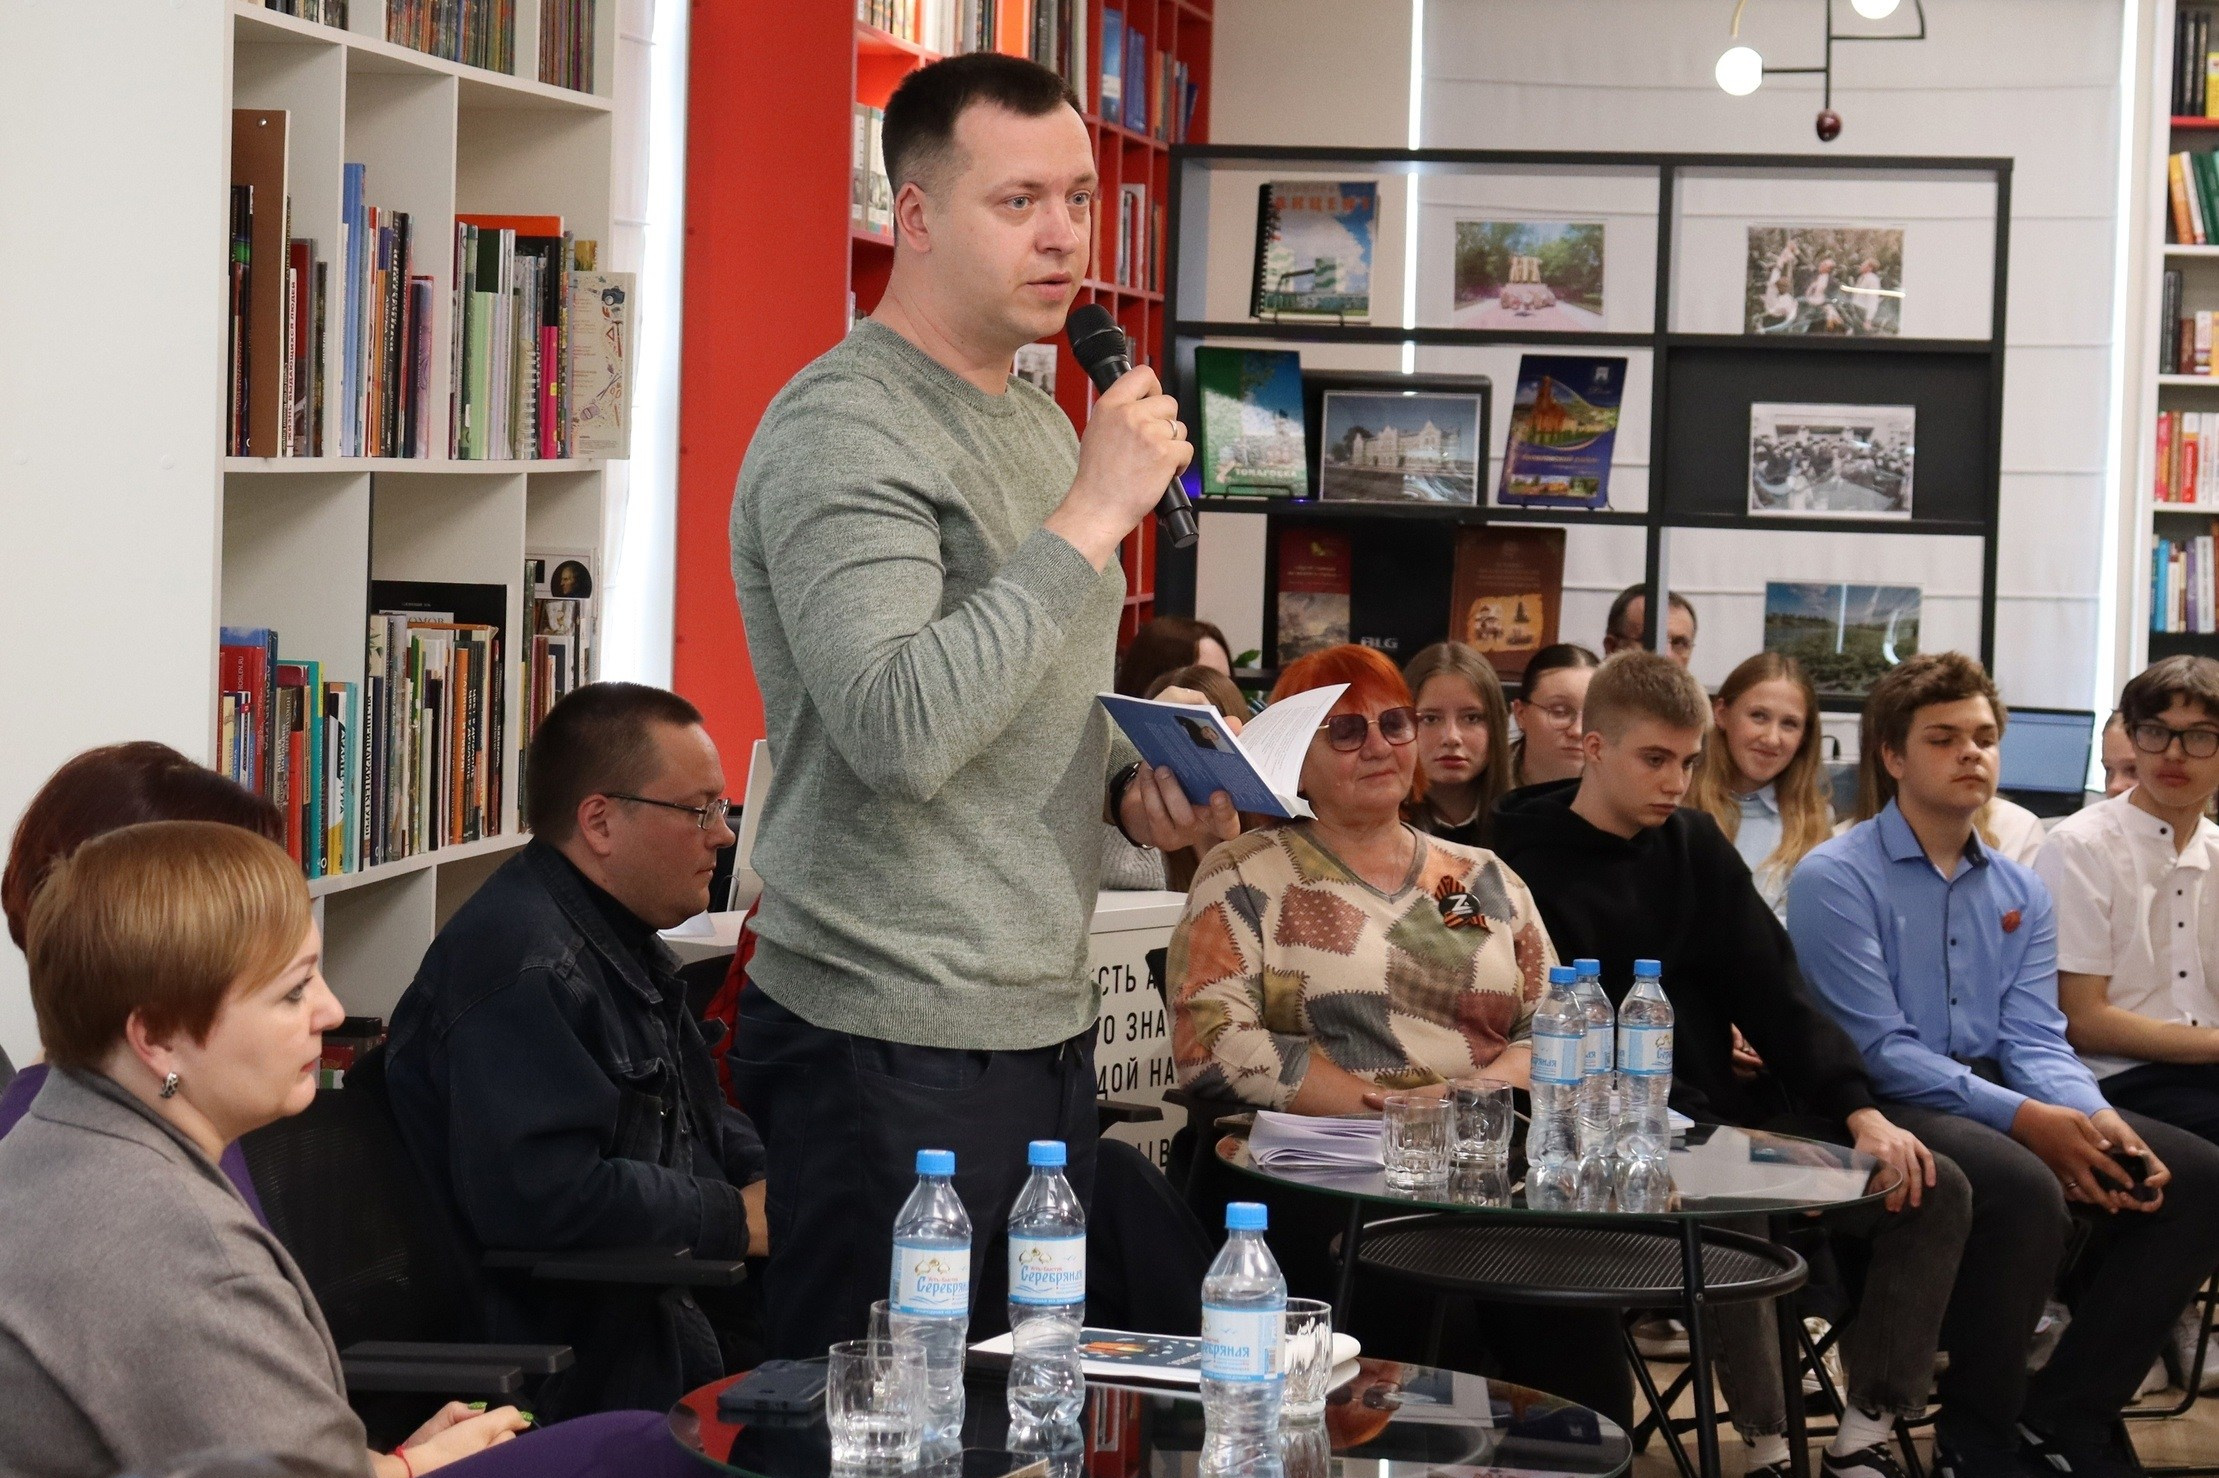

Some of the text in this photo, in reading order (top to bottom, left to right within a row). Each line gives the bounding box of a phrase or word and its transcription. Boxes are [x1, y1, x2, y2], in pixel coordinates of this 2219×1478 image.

[264, 665, 272, 751] АРХИТЕКТУРА
[1093, 964, 1136, 996] СТЬ
[1126, 1009, 1166, 1042] ЗНА
[1097, 1056, 1175, 1100] ДОЙ НА
[1021, 1265, 1083, 1285] Серебряная
